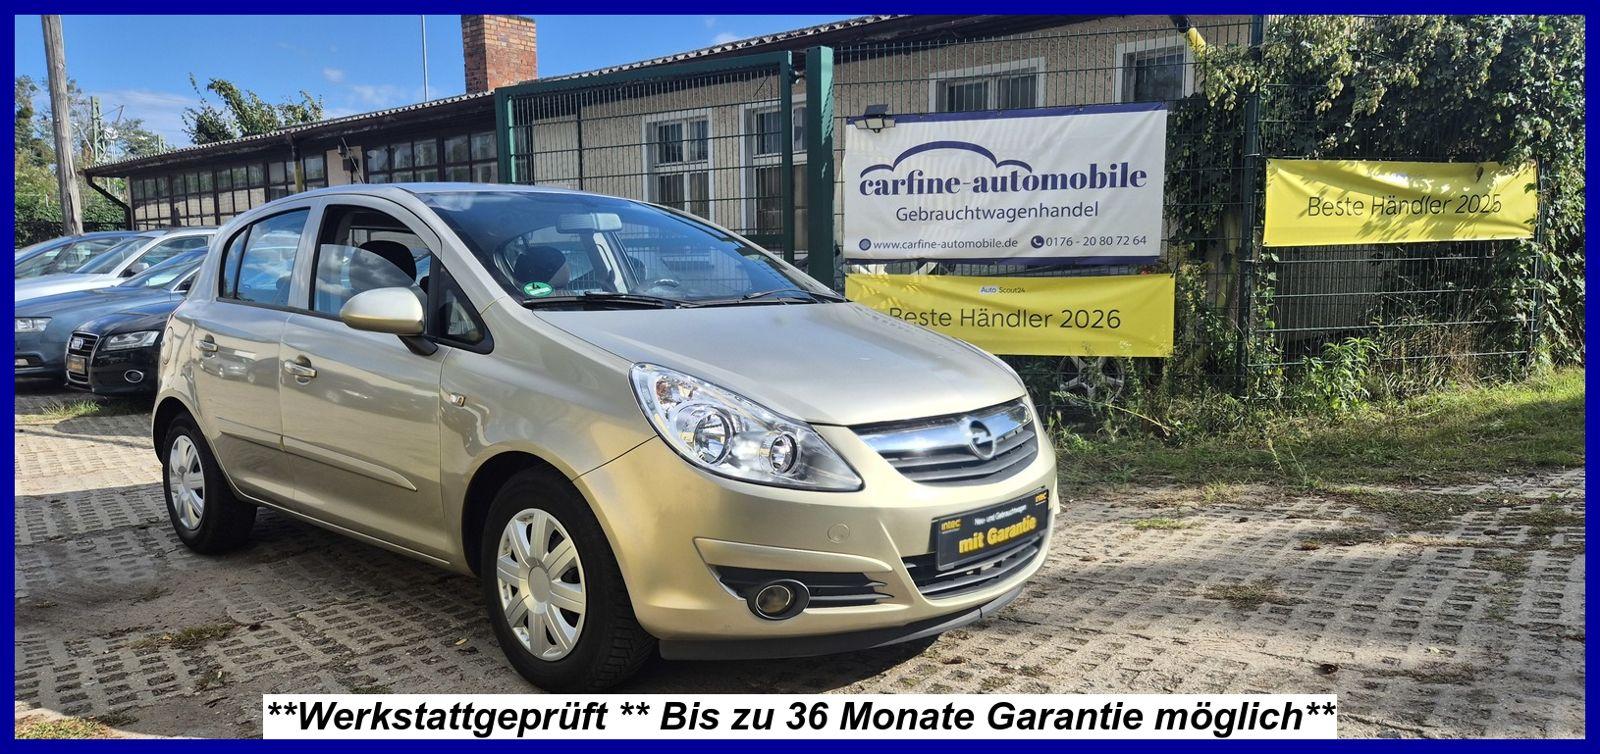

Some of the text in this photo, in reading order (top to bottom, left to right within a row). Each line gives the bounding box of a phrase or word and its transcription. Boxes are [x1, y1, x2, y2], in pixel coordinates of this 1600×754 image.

[859, 161, 1148, 197] carfine-automobile
[895, 201, 1099, 223] Gebrauchtwagenhandel
[1308, 193, 1502, 217] Beste Händler 2025
[873, 237, 1019, 250] www.carfine-automobile.de
[1045, 236, 1074, 247] 0176
[1083, 236, 1097, 247] 20
[1099, 235, 1115, 247] 80
[1116, 234, 1132, 246] 72
[1132, 234, 1148, 246] 64
[999, 286, 1026, 294] Scout24
[959, 309, 1053, 328] Händler
[1059, 309, 1122, 329] 2026
[959, 515, 1037, 553] mit Garantie
